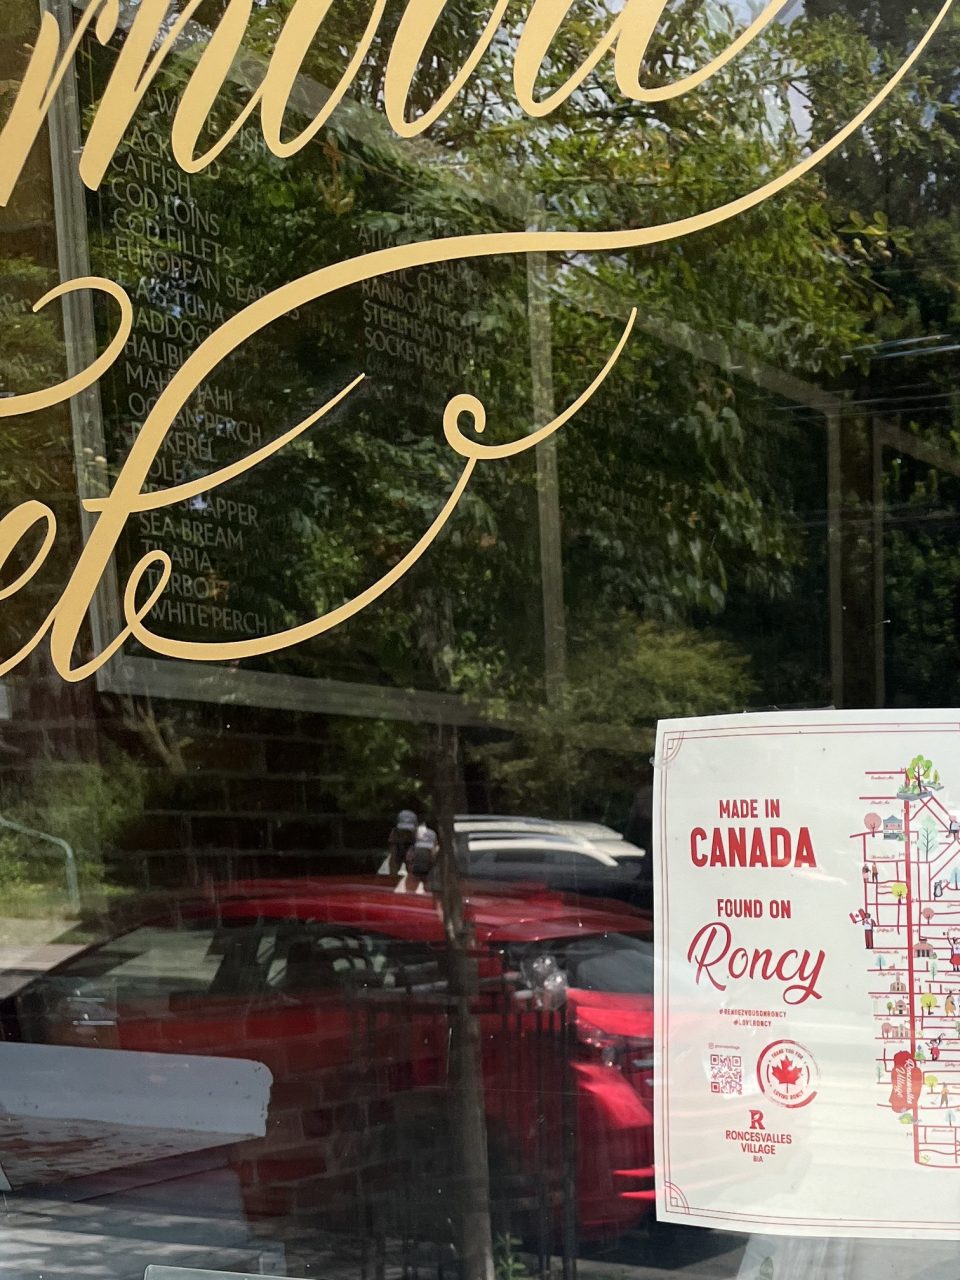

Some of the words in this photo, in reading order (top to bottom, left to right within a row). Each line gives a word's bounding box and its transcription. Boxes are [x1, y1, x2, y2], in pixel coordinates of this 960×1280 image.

[719, 799, 759, 818] MADE
[765, 798, 781, 818] IN
[690, 826, 818, 868] CANADA
[717, 898, 763, 918] FOUND
[769, 899, 791, 919] ON
[687, 922, 826, 1005] Roncy
[725, 1129, 793, 1145] RONCESVALLES
[741, 1142, 777, 1156] VILLAGE
[753, 1155, 764, 1163] BIA
